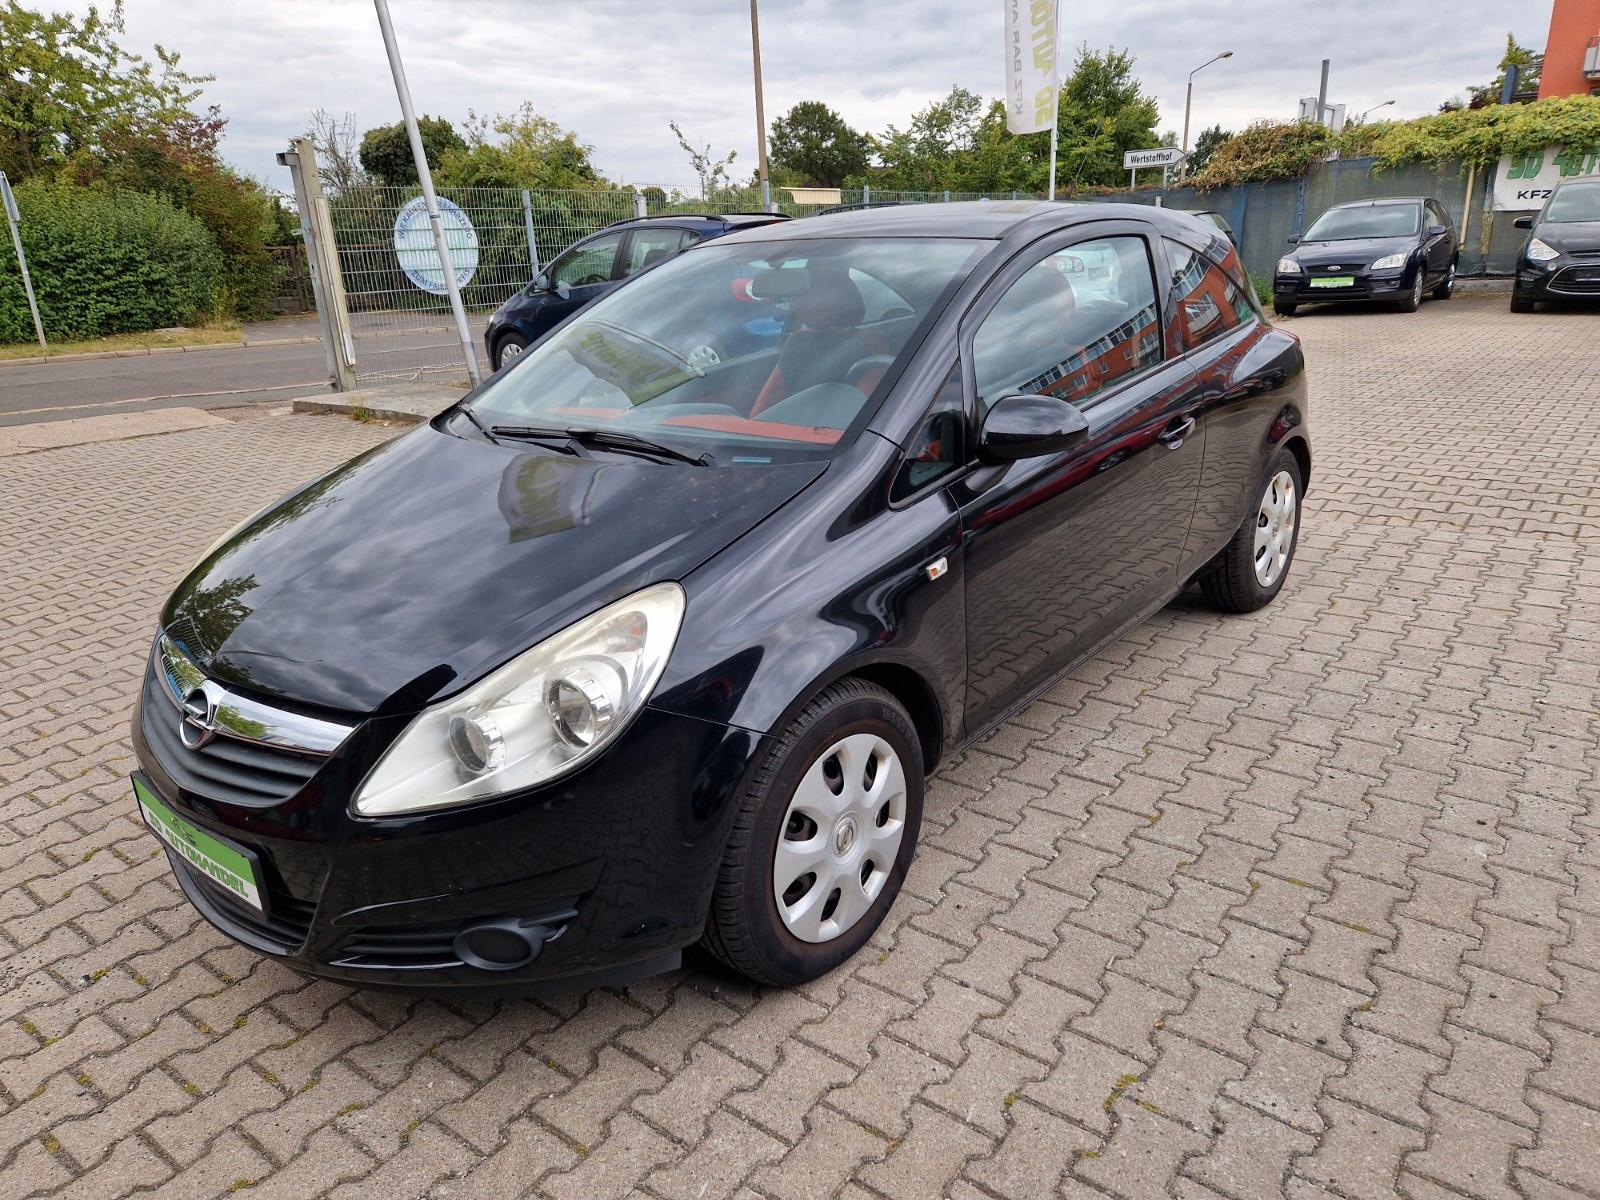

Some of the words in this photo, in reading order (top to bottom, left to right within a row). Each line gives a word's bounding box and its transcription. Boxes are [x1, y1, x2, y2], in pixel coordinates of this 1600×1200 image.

[1130, 151, 1172, 164] Wertstoffhof
[1517, 190, 1552, 200] KFZ
[411, 270, 428, 285] ZUM
[456, 268, 471, 285] REIS
